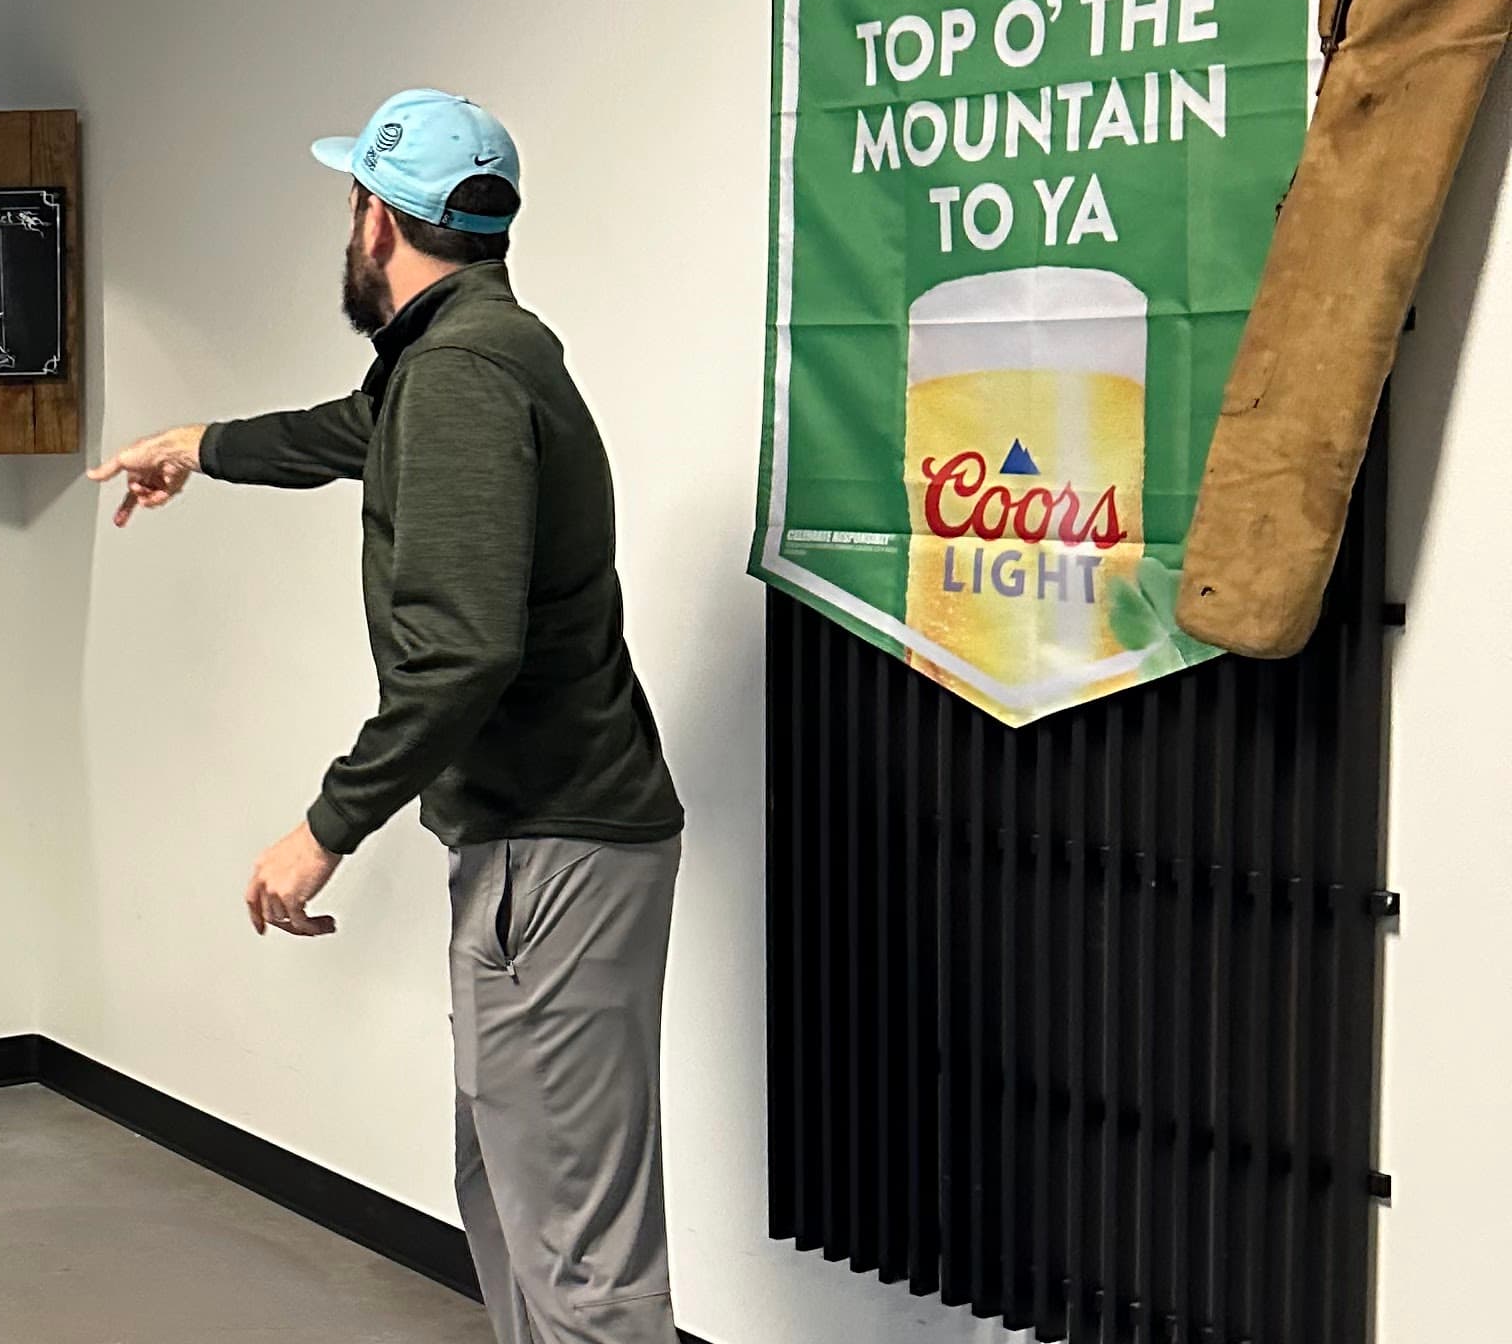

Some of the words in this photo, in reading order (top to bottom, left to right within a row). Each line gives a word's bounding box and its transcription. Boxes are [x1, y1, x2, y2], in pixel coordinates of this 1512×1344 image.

[855, 8, 976, 86] TOP
[851, 63, 1227, 173] MOUNTAIN
[929, 182, 1014, 252] TO
[1033, 173, 1119, 246] YA
[921, 451, 1128, 550] Coors
[943, 545, 1104, 604] LIGHT
